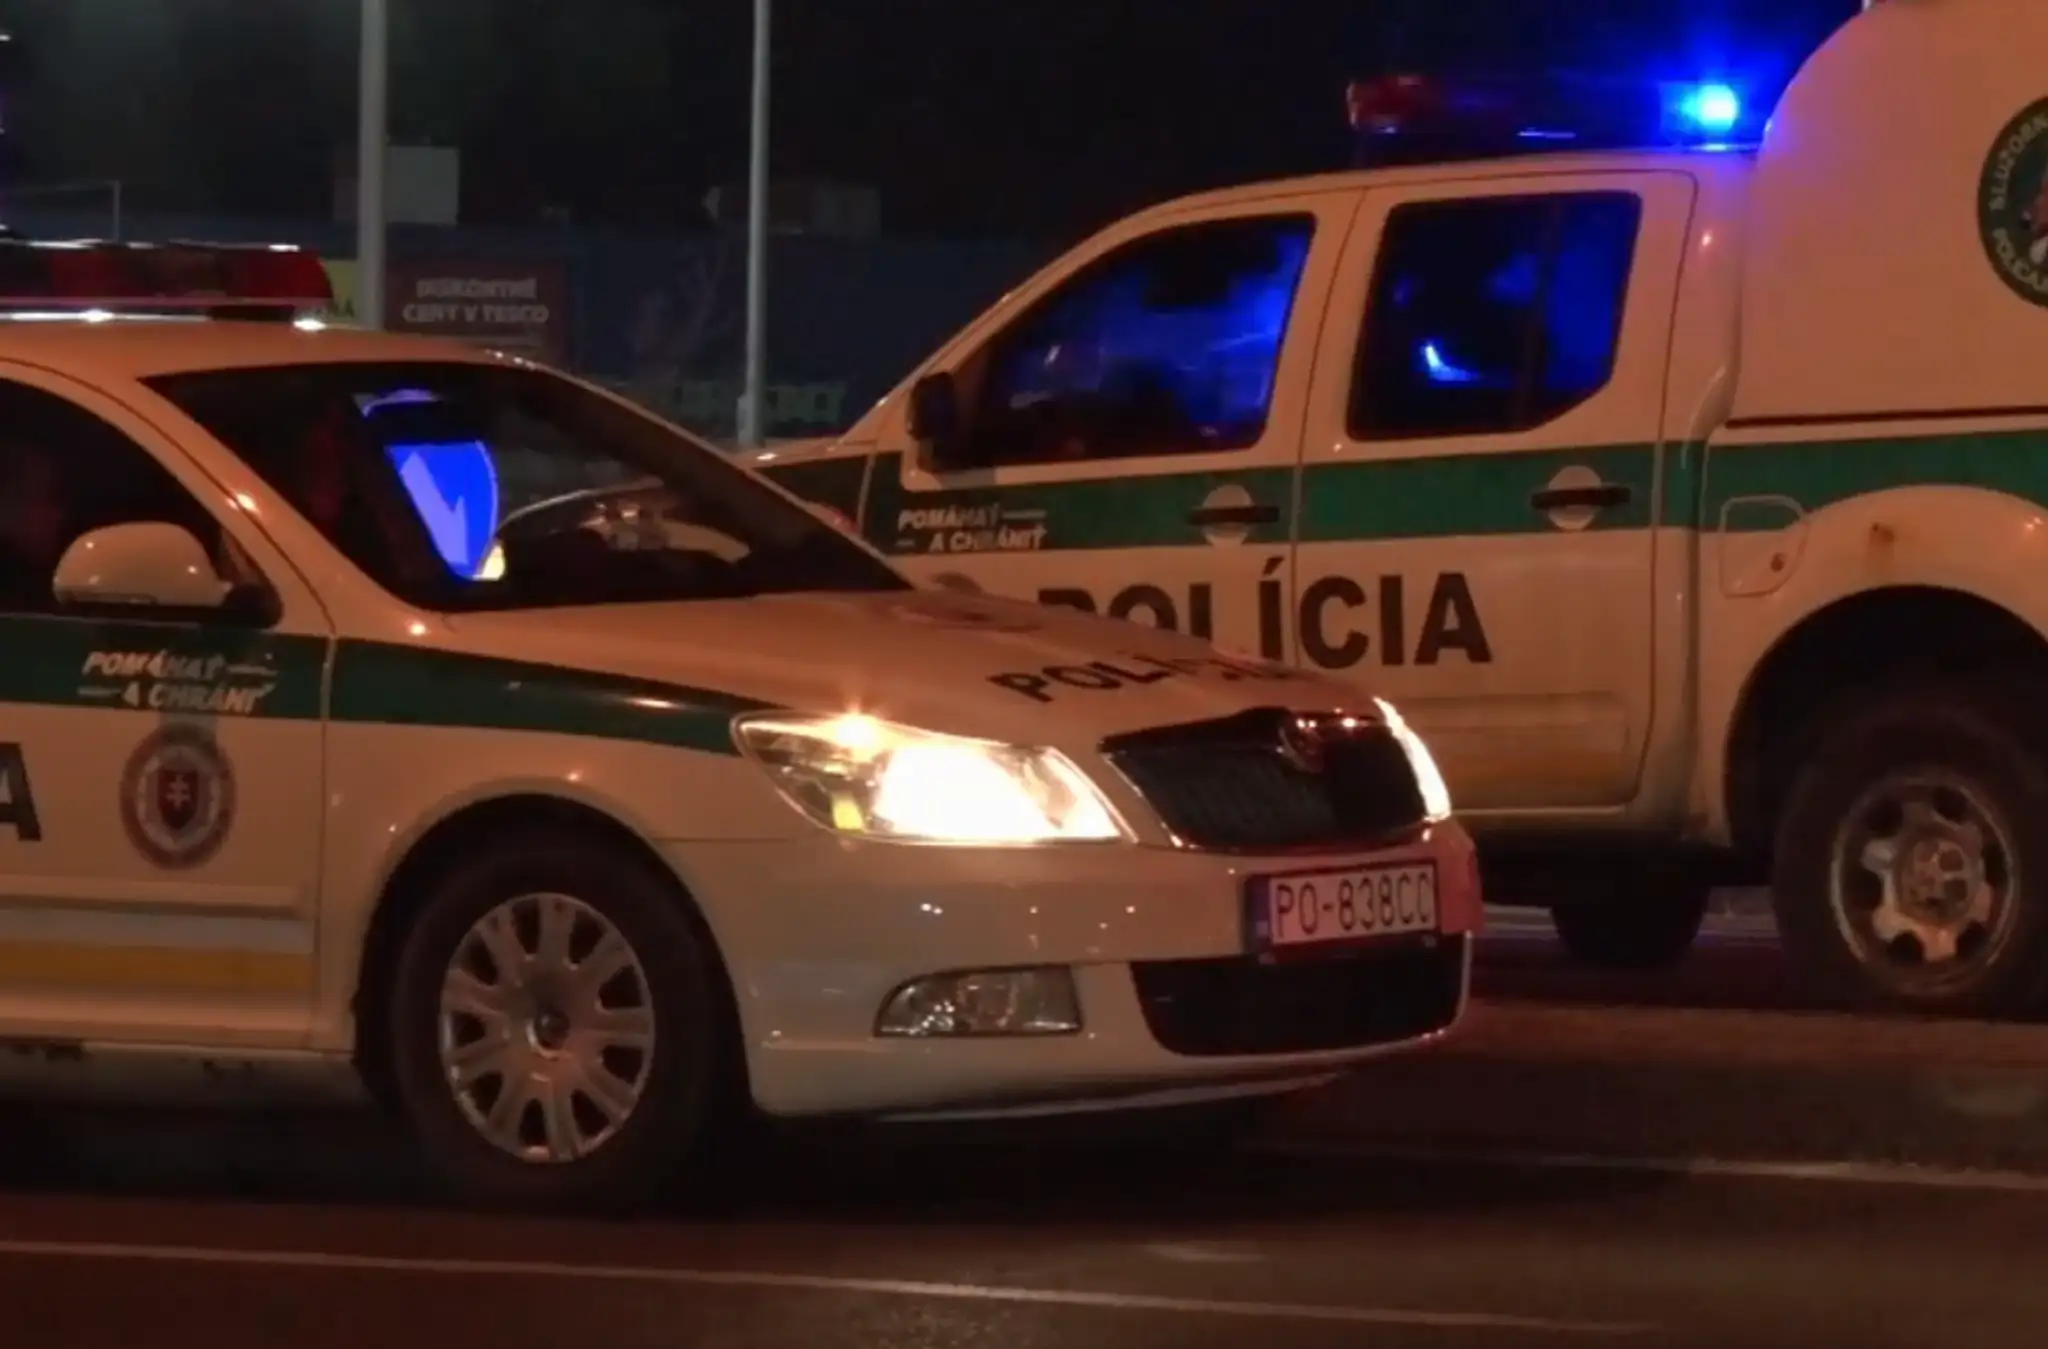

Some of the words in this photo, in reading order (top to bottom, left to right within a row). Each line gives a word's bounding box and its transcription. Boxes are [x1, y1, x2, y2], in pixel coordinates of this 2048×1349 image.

[402, 303, 457, 323] CENY
[463, 304, 478, 323] V
[482, 304, 550, 323] TESCO
[929, 532, 945, 552] A
[1038, 556, 1492, 670] OLÍCIA
[122, 681, 141, 708] A
